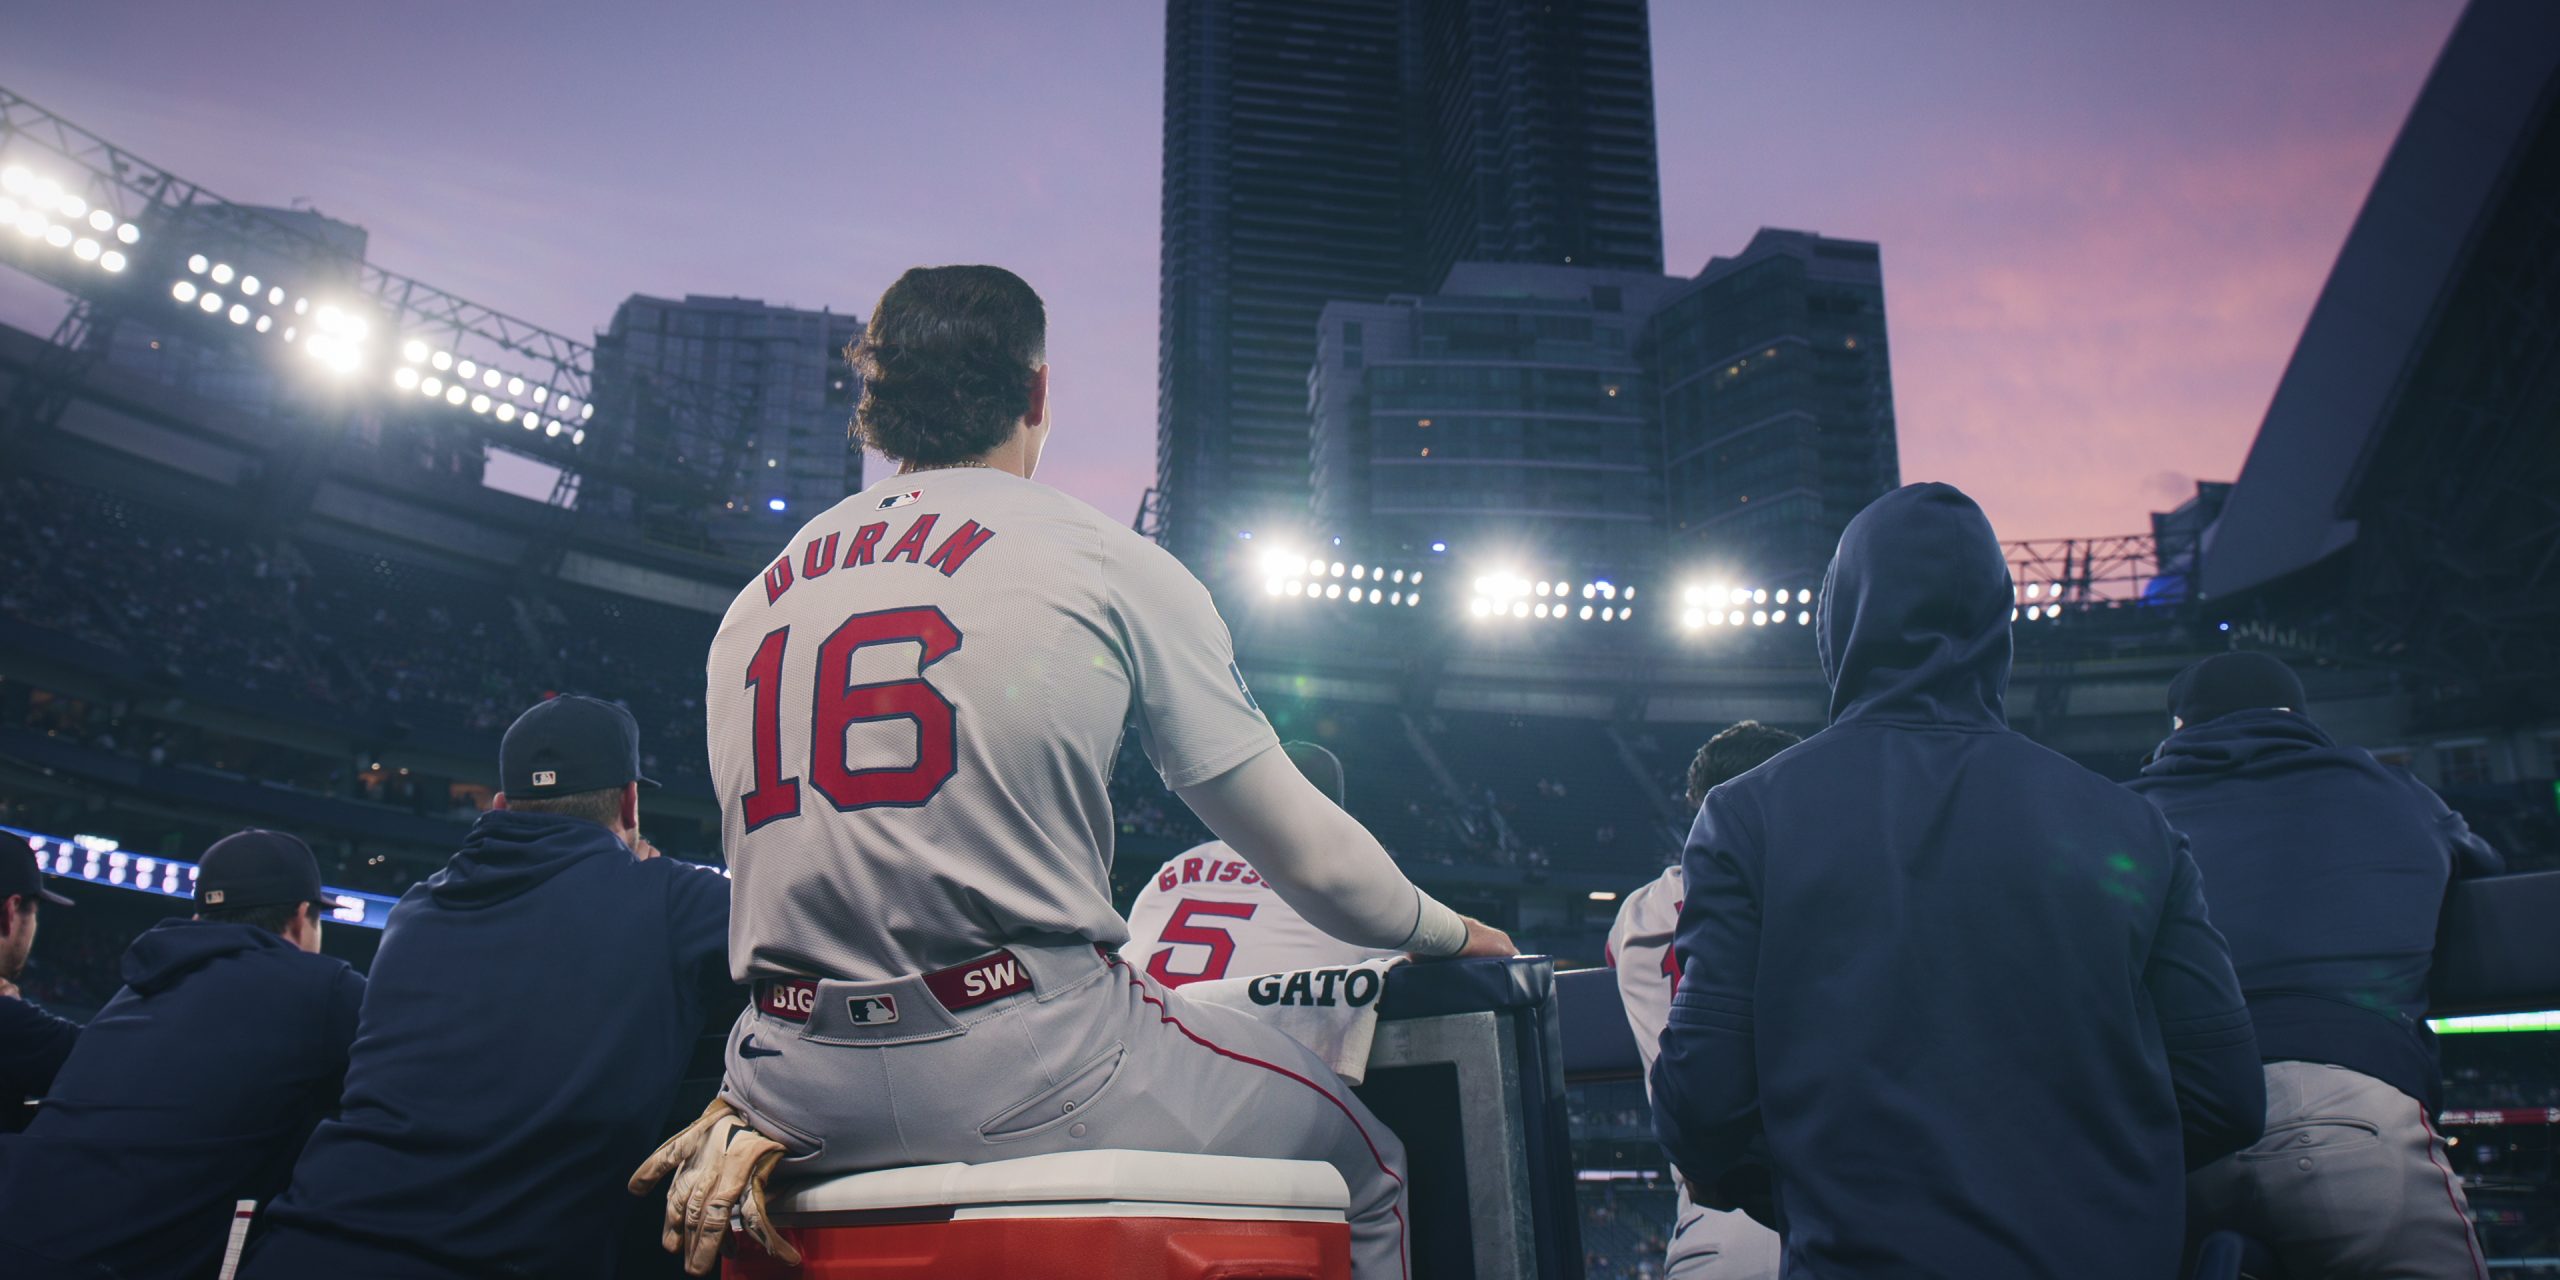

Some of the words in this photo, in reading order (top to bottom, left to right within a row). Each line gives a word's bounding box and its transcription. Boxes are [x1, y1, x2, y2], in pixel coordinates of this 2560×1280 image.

[764, 513, 996, 606] DURAN
[741, 605, 963, 834] 16
[1158, 857, 1271, 892] GRISS
[1146, 898, 1258, 990] 5
[773, 984, 814, 1013] BIG
[1248, 968, 1388, 1012] GATO
